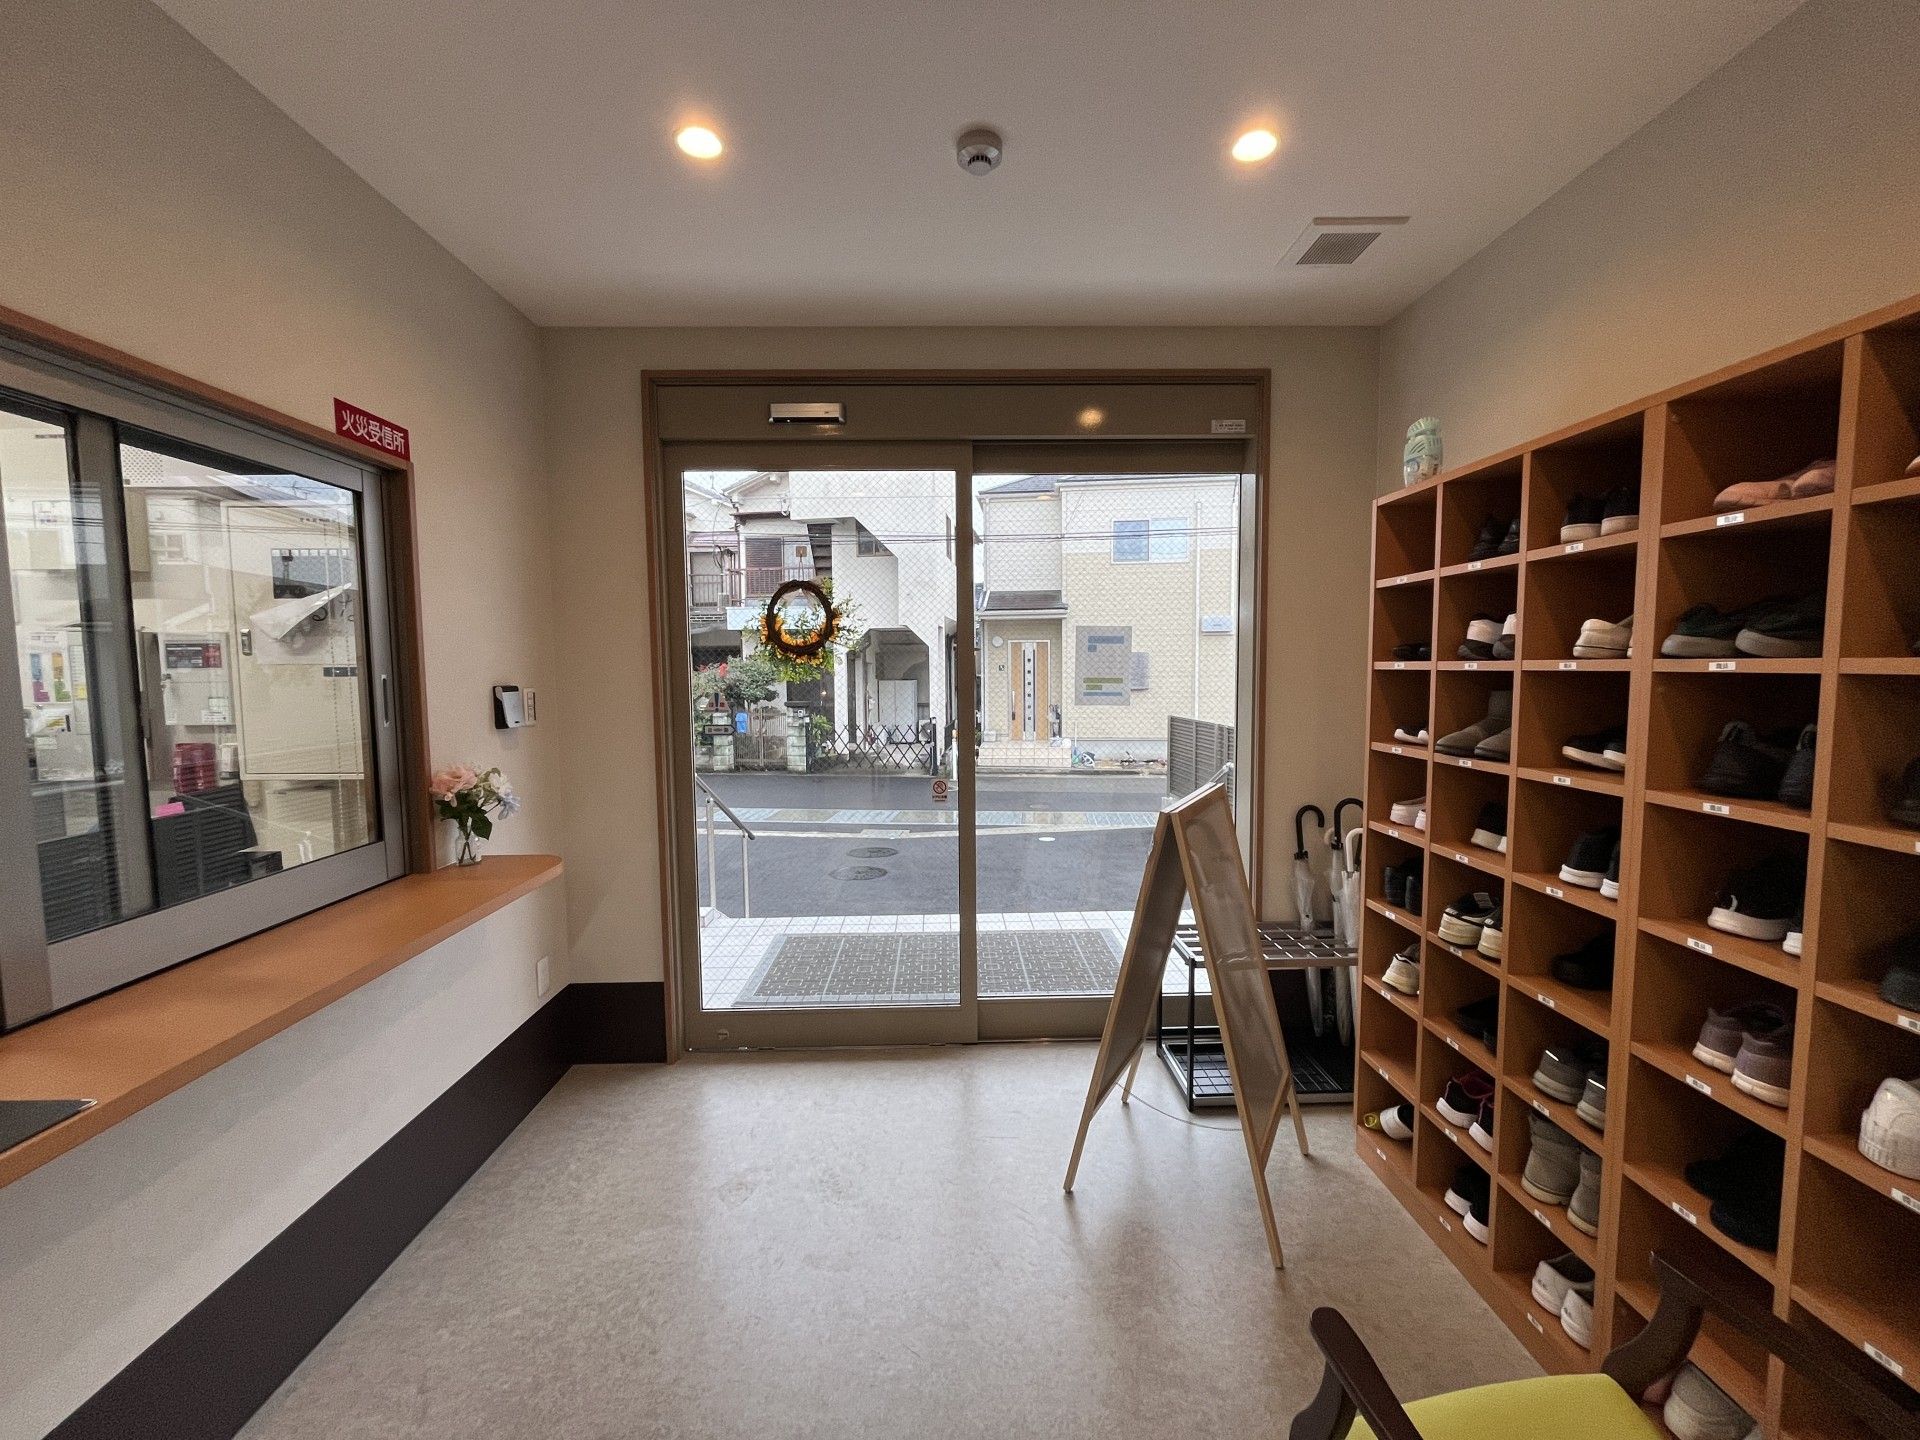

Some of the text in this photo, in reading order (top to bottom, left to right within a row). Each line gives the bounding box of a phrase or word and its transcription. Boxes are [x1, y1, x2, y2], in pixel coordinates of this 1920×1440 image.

[342, 410, 405, 454] 火災受信所
